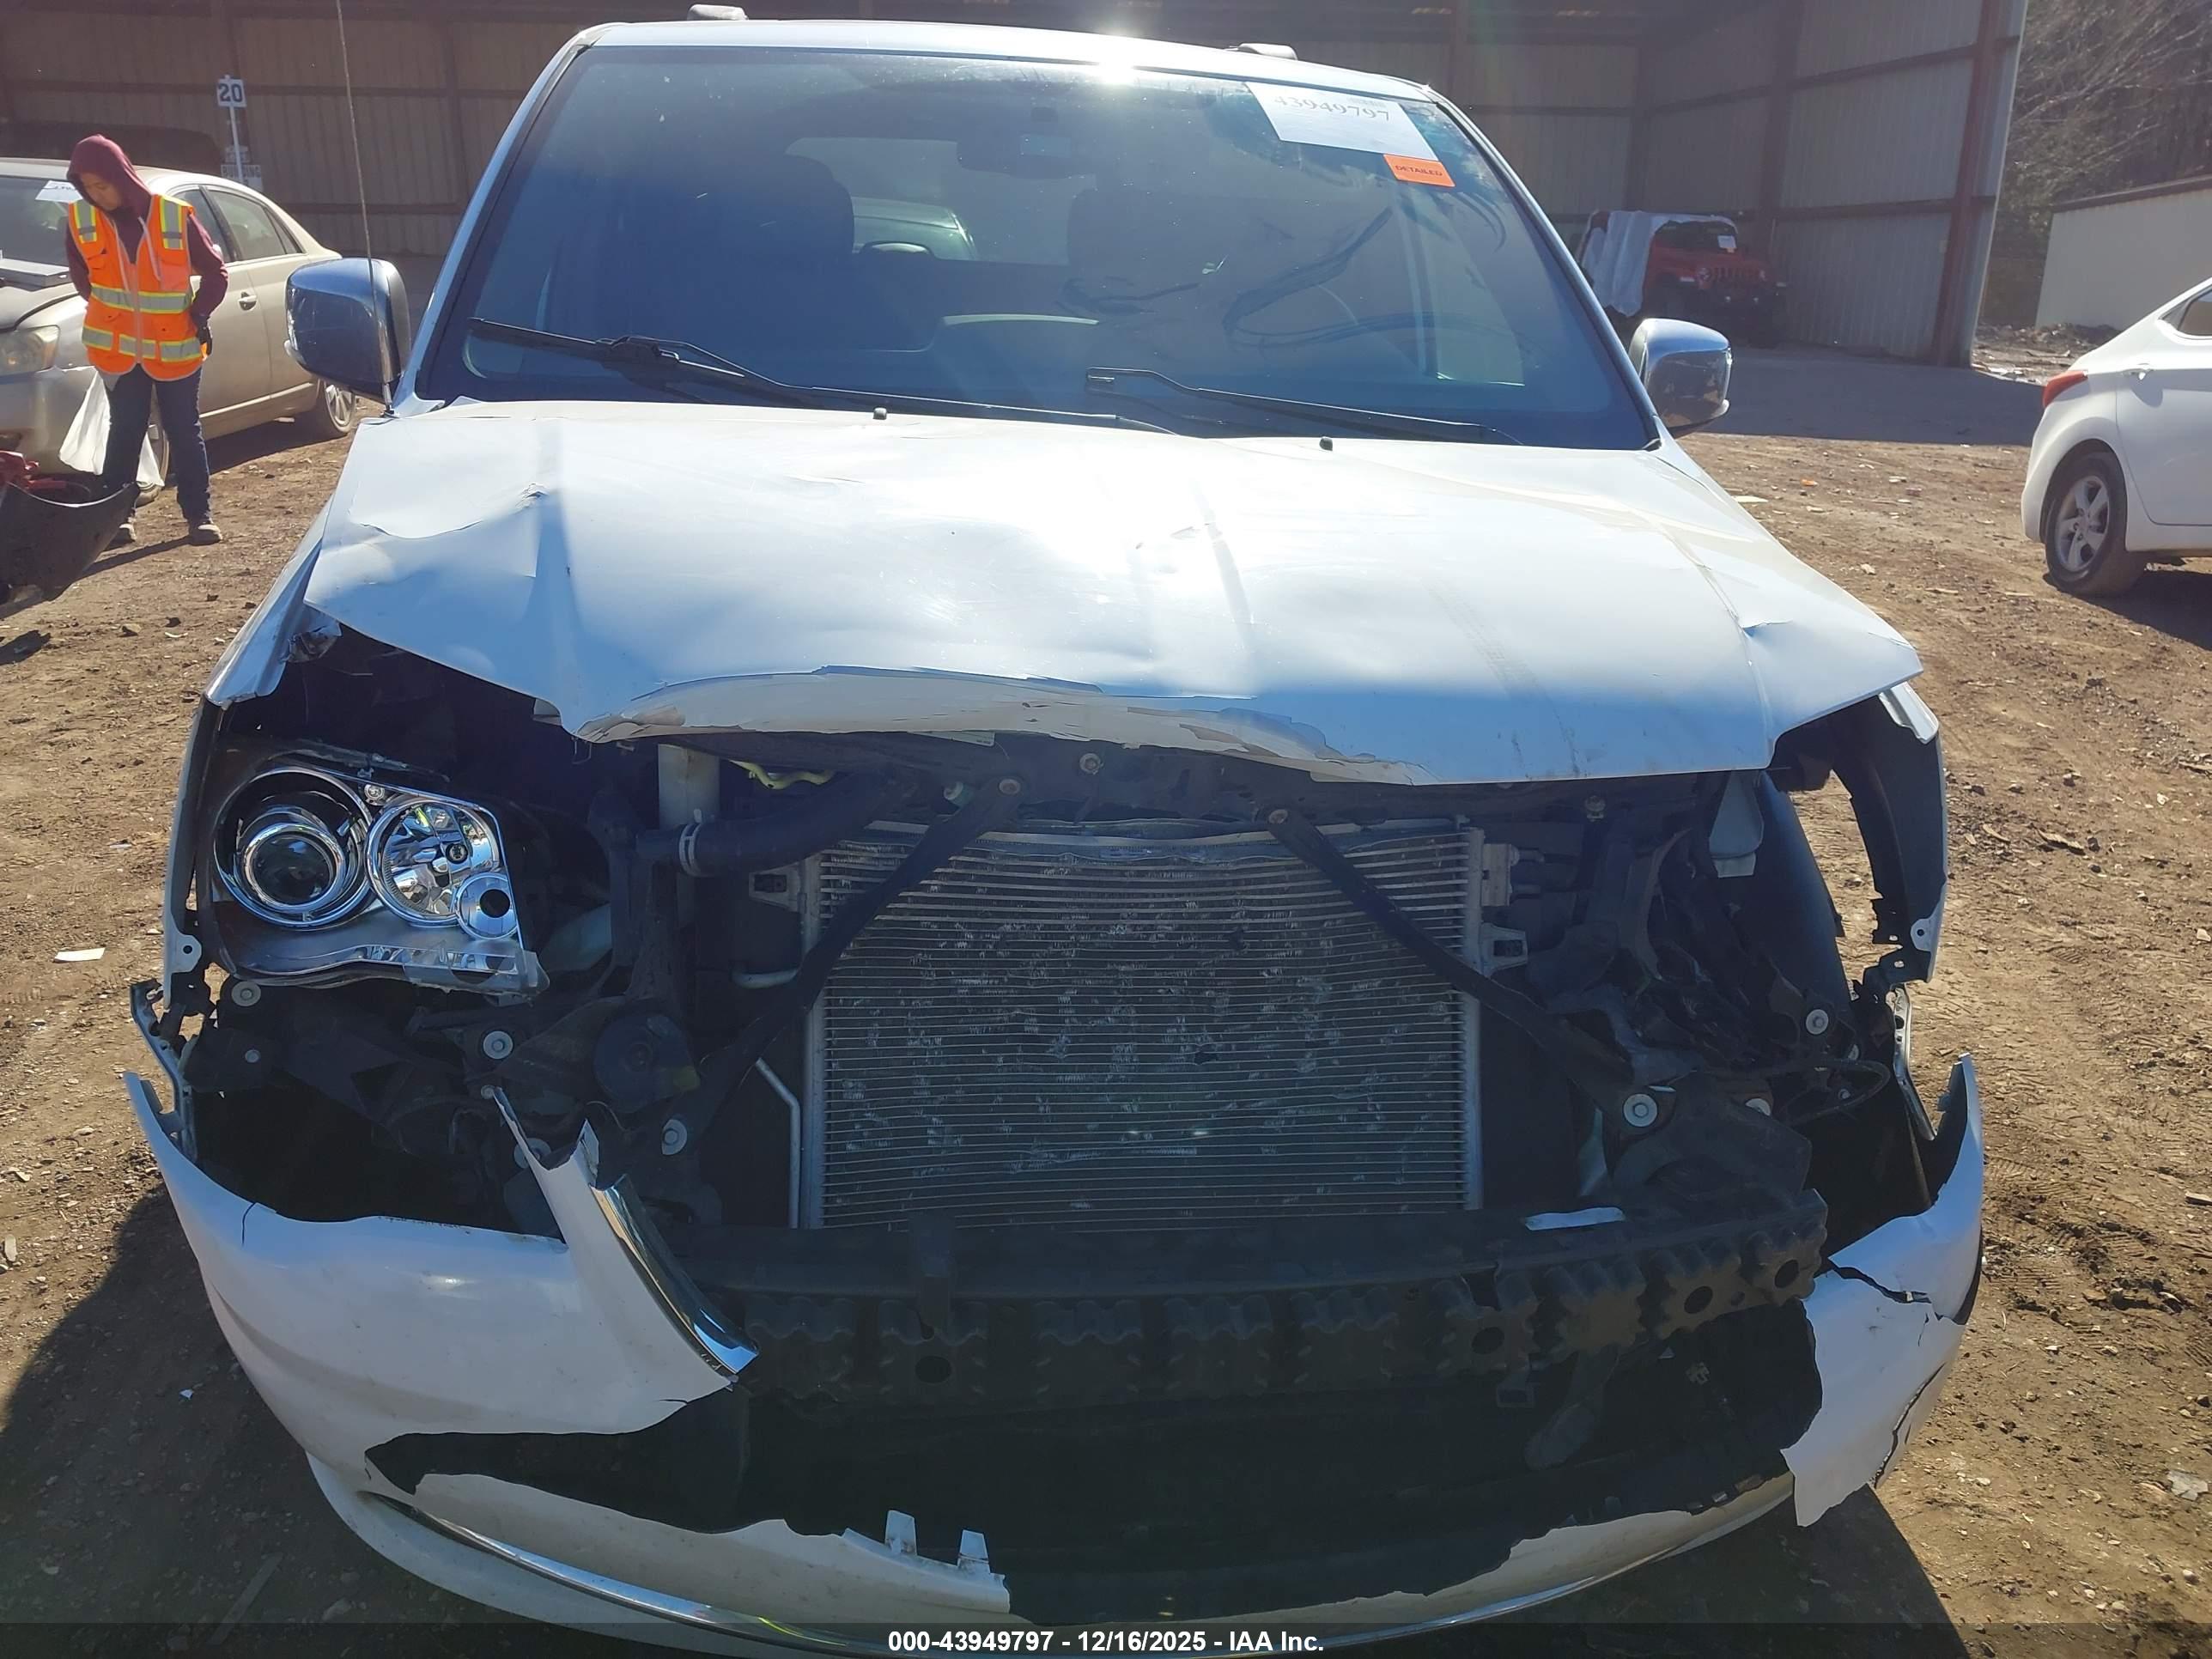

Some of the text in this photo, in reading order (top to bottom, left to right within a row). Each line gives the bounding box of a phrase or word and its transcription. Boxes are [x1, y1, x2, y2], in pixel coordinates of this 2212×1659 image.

[218, 83, 243, 102] 20
[1274, 96, 1389, 121] 43949797
[222, 165, 261, 179] BUIDING
[1395, 164, 1443, 177] DETAILED
